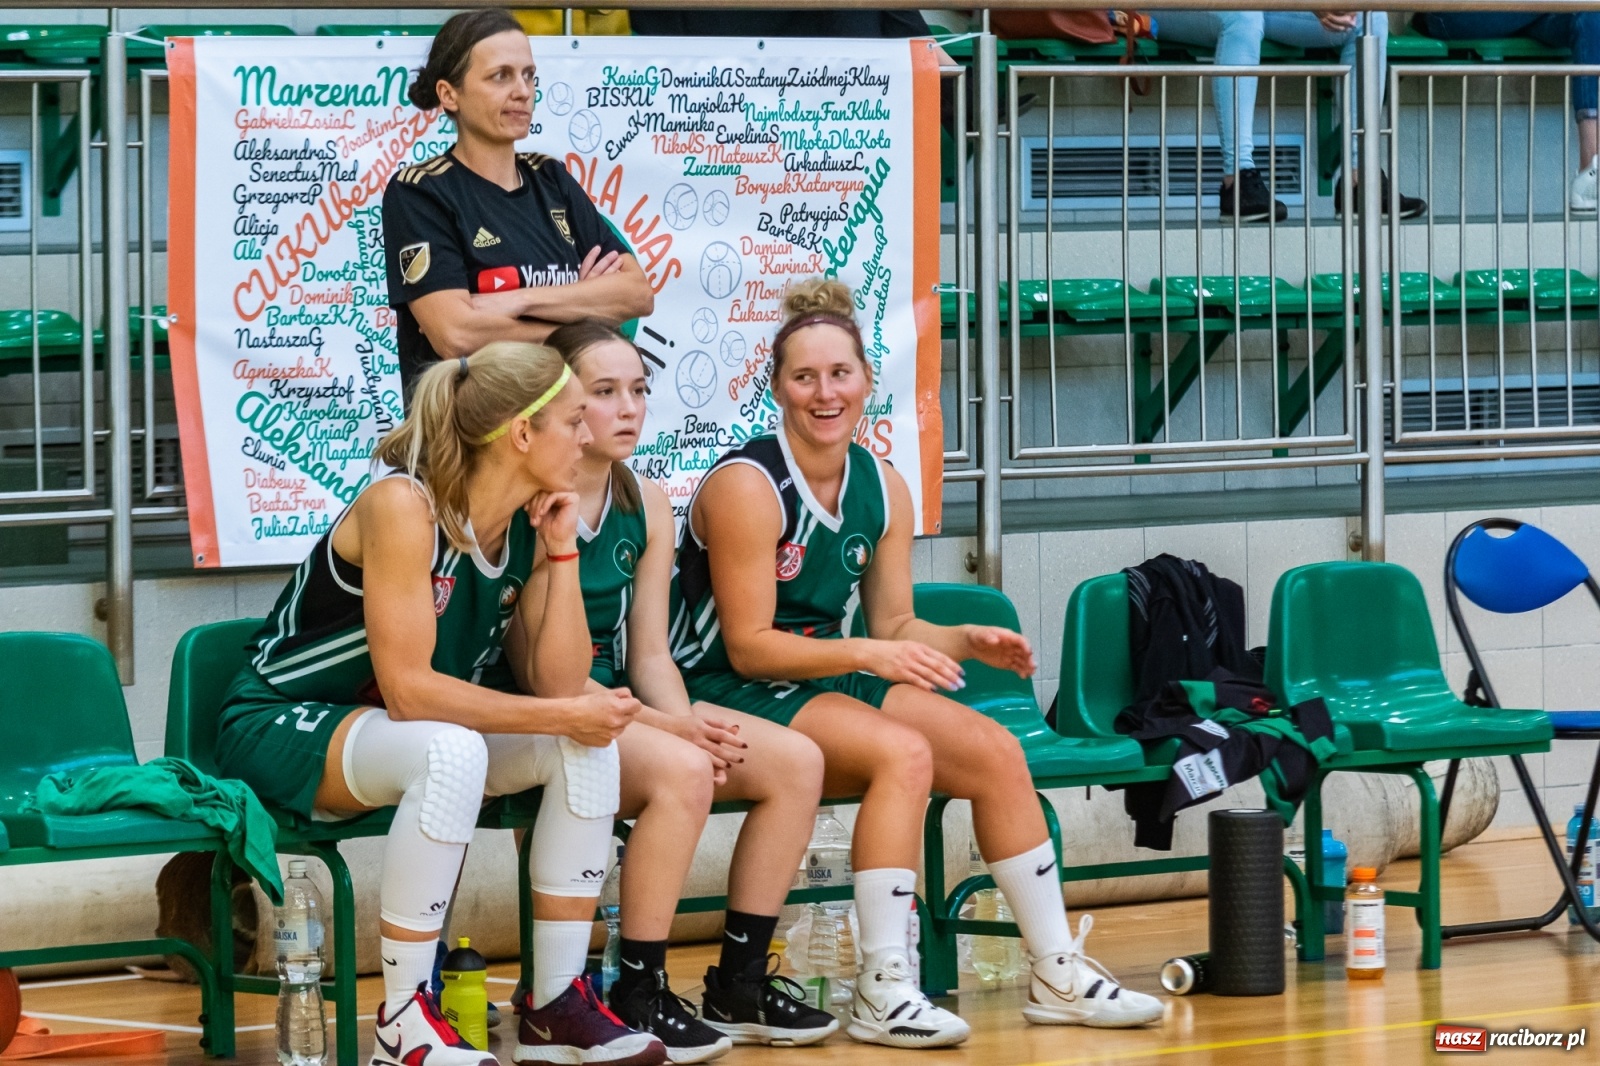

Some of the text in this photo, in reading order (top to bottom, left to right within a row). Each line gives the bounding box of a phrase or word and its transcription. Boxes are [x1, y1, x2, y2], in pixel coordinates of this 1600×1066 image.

[602, 65, 660, 96] KasiaG
[668, 91, 745, 114] MariolaH
[645, 110, 714, 133] Maminka
[716, 122, 779, 145] EwelinaS
[605, 110, 647, 161] EwaK
[652, 131, 705, 155] NikolS
[780, 128, 891, 151] MkotaDlaKota
[234, 137, 337, 161] AleksandraS
[706, 142, 784, 164] MateuszK
[250, 159, 359, 183] SenectusMed
[683, 156, 741, 177] Zuzanna
[784, 150, 865, 173] ArkadiuszL
[233, 183, 323, 215] GrzegorzP
[565, 152, 623, 215] DLA
[624, 194, 682, 294] WAS
[780, 201, 849, 232] PatrycjaS
[234, 213, 278, 247] Alicja
[473, 236, 501, 247] adidas
[757, 212, 823, 254] BartekK
[233, 237, 262, 261] Ala
[740, 235, 793, 256] Damian
[760, 253, 825, 276] KarinaK
[289, 281, 353, 305] Dominik
[265, 305, 347, 327] BartoszK
[235, 327, 325, 357] NastaszaG
[233, 356, 333, 390] AgnieszkaK
[728, 337, 773, 401] PiotrK
[269, 375, 354, 408] Krzysztof
[282, 398, 373, 421] KarolinaD
[306, 421, 359, 441] AniaP
[684, 413, 717, 436] Beno
[241, 436, 287, 471] Elunia
[246, 490, 326, 514] BeataFran
